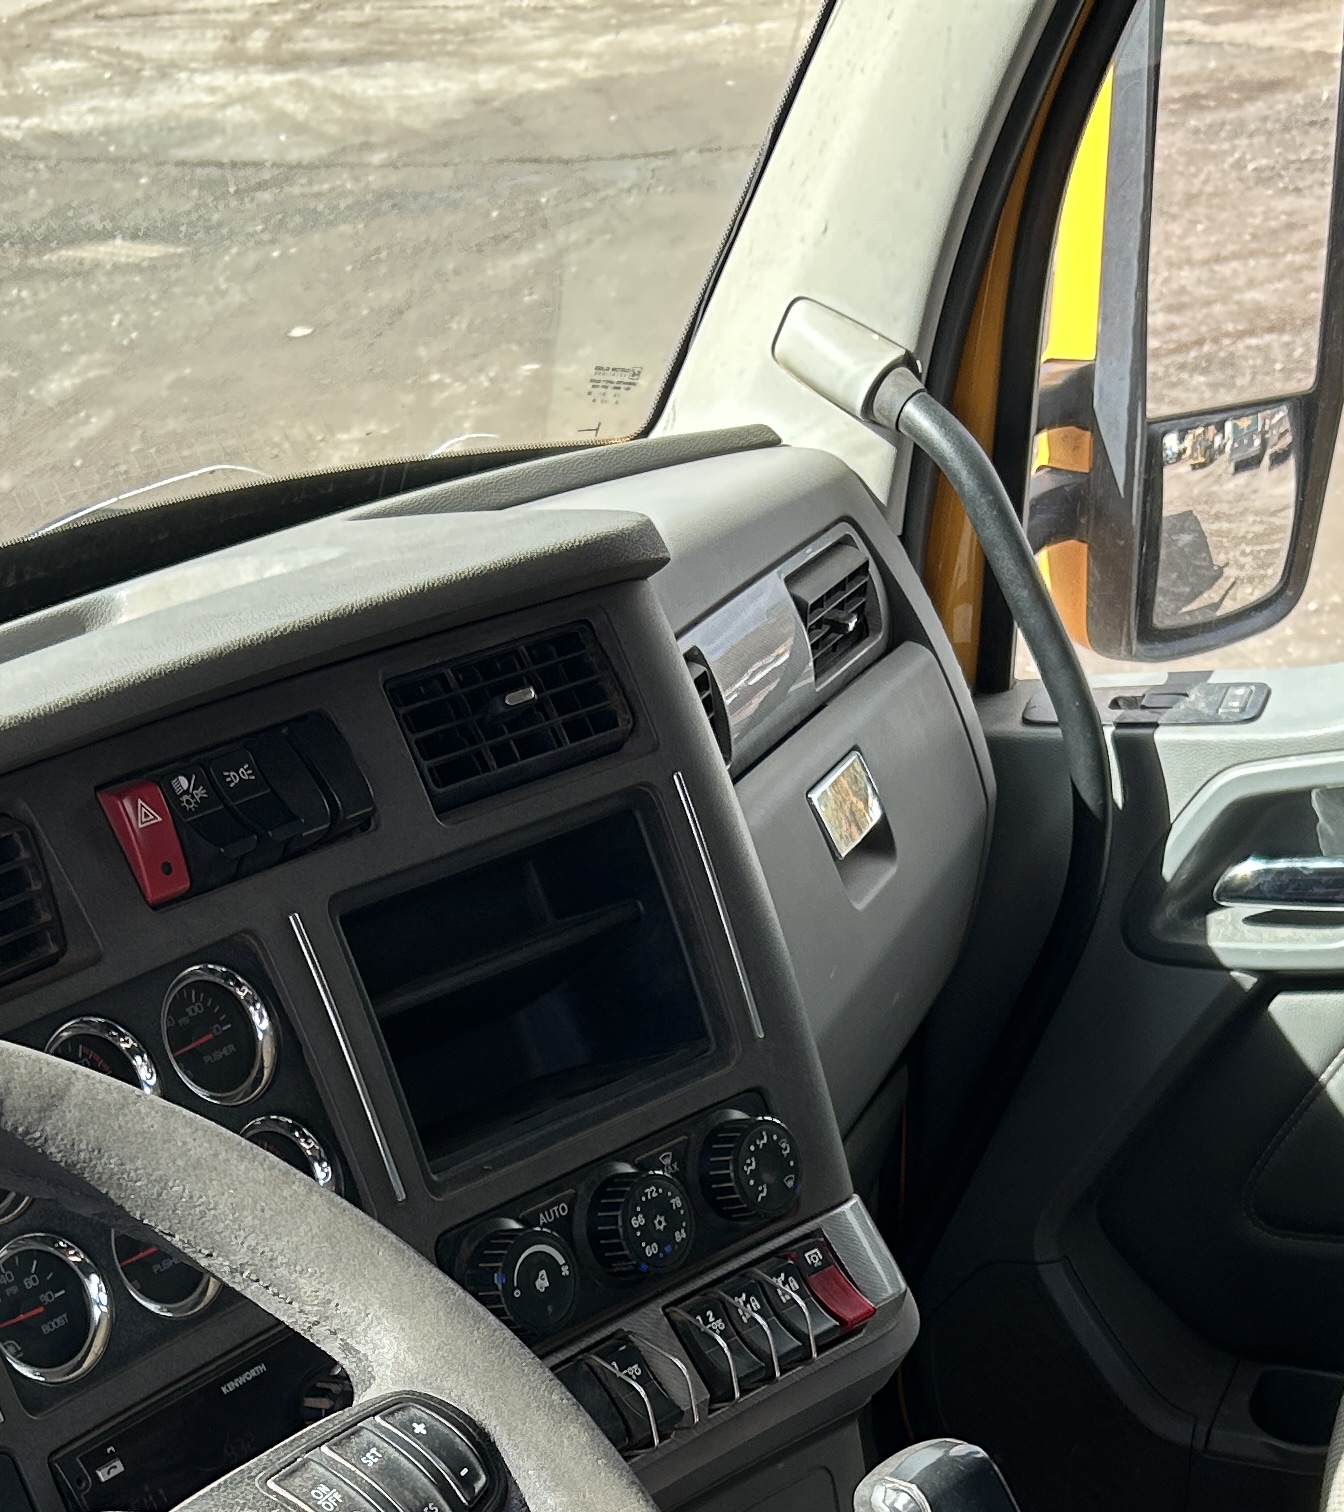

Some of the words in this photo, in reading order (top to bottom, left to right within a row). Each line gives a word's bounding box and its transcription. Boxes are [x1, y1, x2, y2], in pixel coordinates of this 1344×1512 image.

[185, 1002, 205, 1018] 100
[202, 1043, 237, 1065] PUSHER
[644, 1185, 659, 1200] 72
[670, 1196, 683, 1210] 78
[538, 1202, 569, 1227] AUTO
[631, 1214, 646, 1228] 66
[674, 1228, 687, 1243] 84
[645, 1242, 659, 1258] 60
[0, 1270, 15, 1285] 40
[23, 1274, 40, 1289] 60
[5, 1285, 19, 1296] PSI
[39, 1290, 55, 1305] 90
[41, 1313, 69, 1335] BOOST
[705, 1310, 715, 1323] 2
[220, 1363, 268, 1395] KENWORTH
[360, 1447, 383, 1467] SET
[311, 1484, 331, 1499] ON
[322, 1491, 344, 1512] OFF
